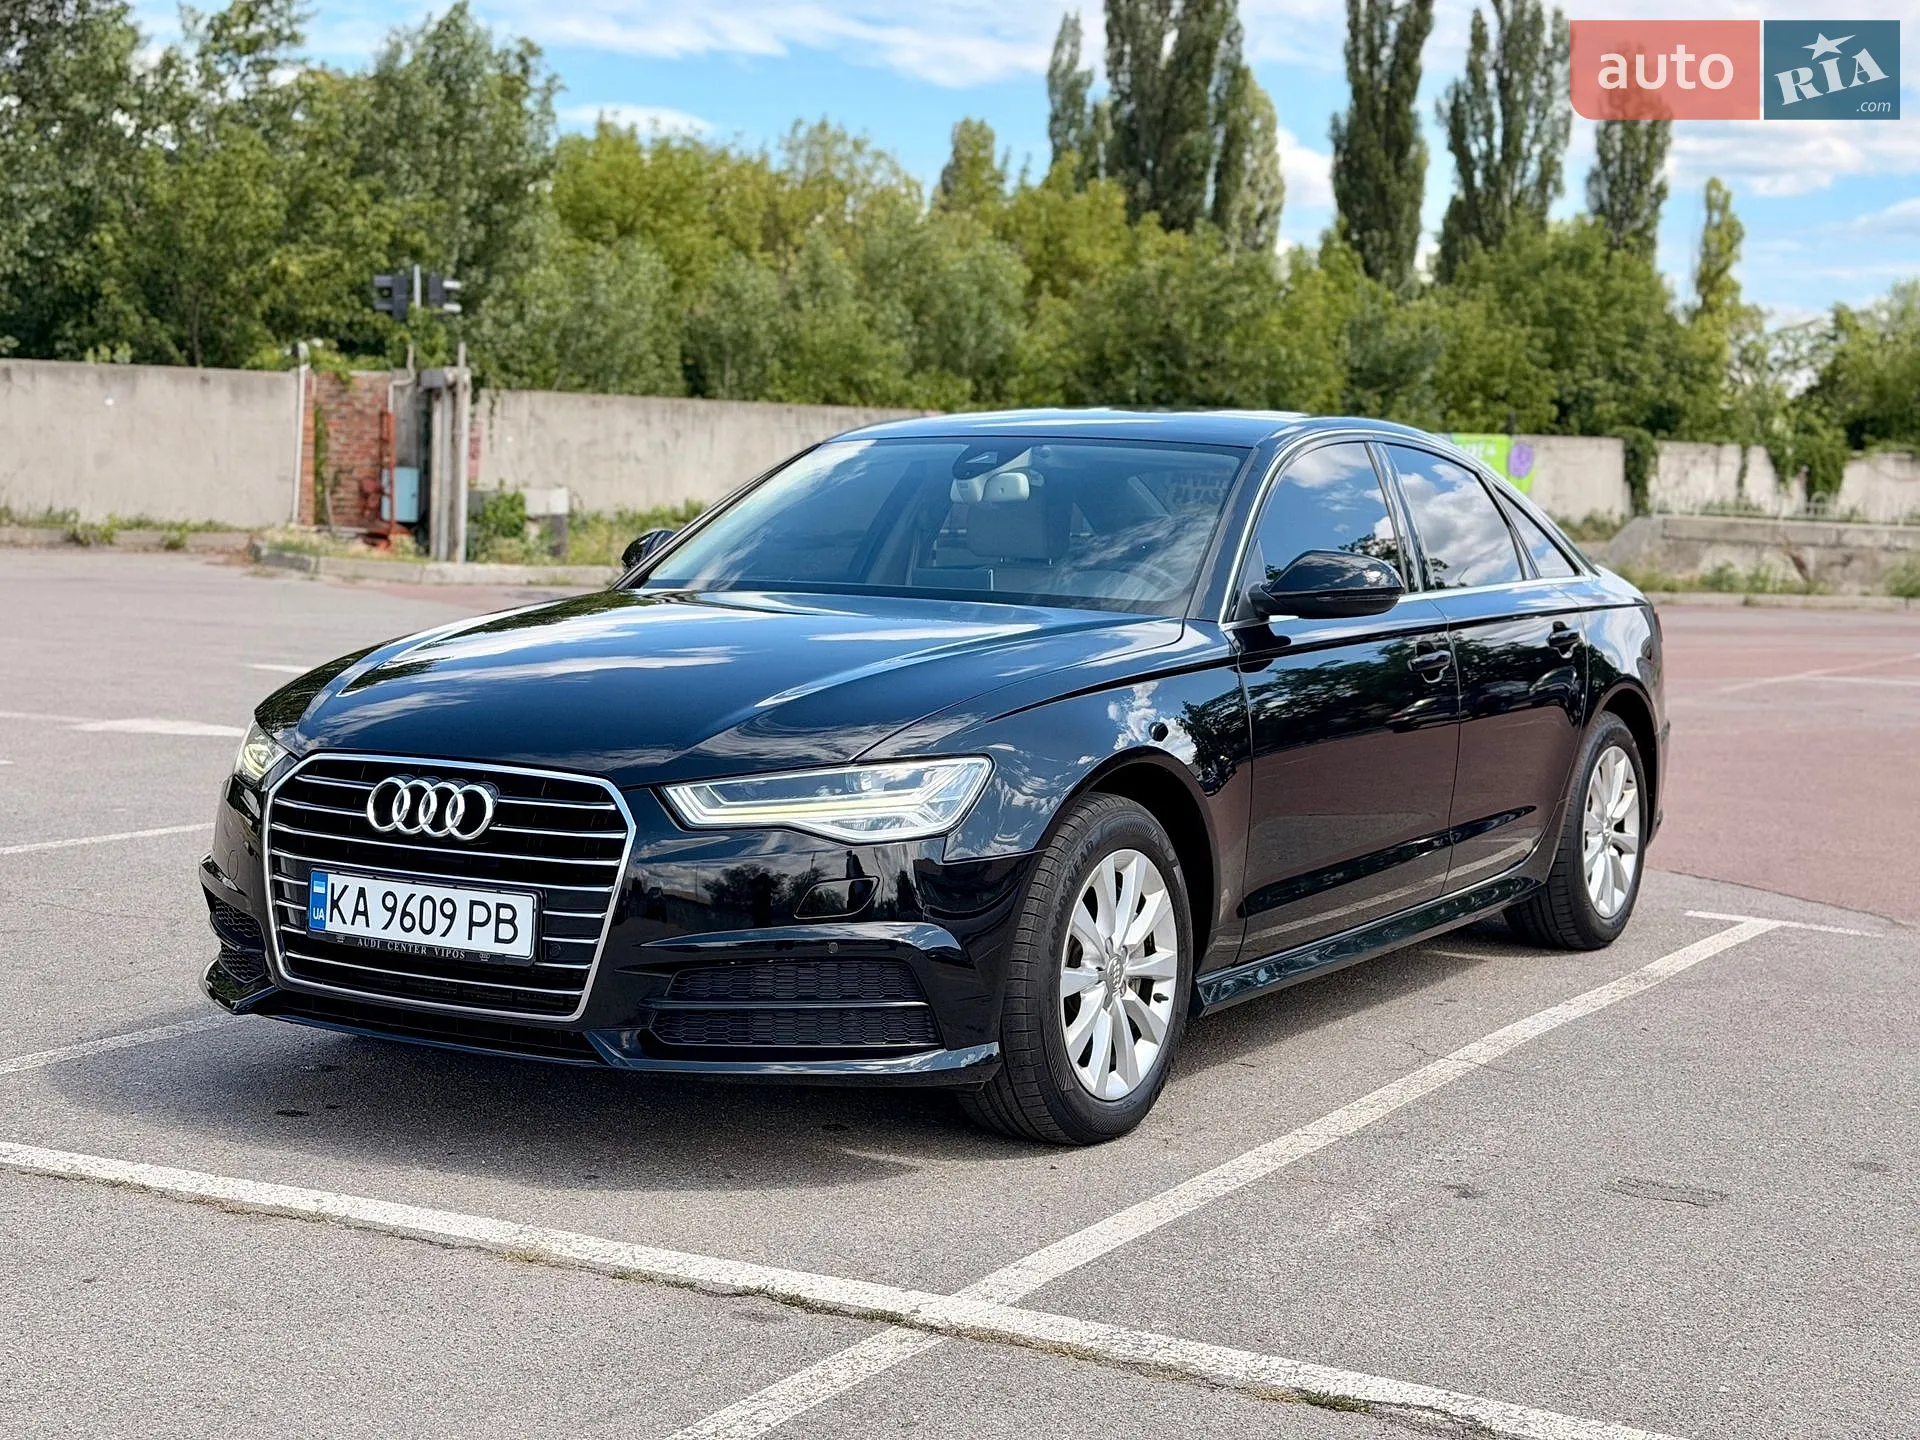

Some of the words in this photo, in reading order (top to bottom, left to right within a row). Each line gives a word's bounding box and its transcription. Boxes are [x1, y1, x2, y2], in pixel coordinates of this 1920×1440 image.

[313, 907, 325, 921] UA
[329, 882, 370, 928] KA
[381, 890, 457, 938] 9609
[467, 899, 519, 944] PB
[356, 938, 381, 949] AUDI
[387, 941, 427, 956] CENTER
[433, 947, 466, 960] VIPOS
